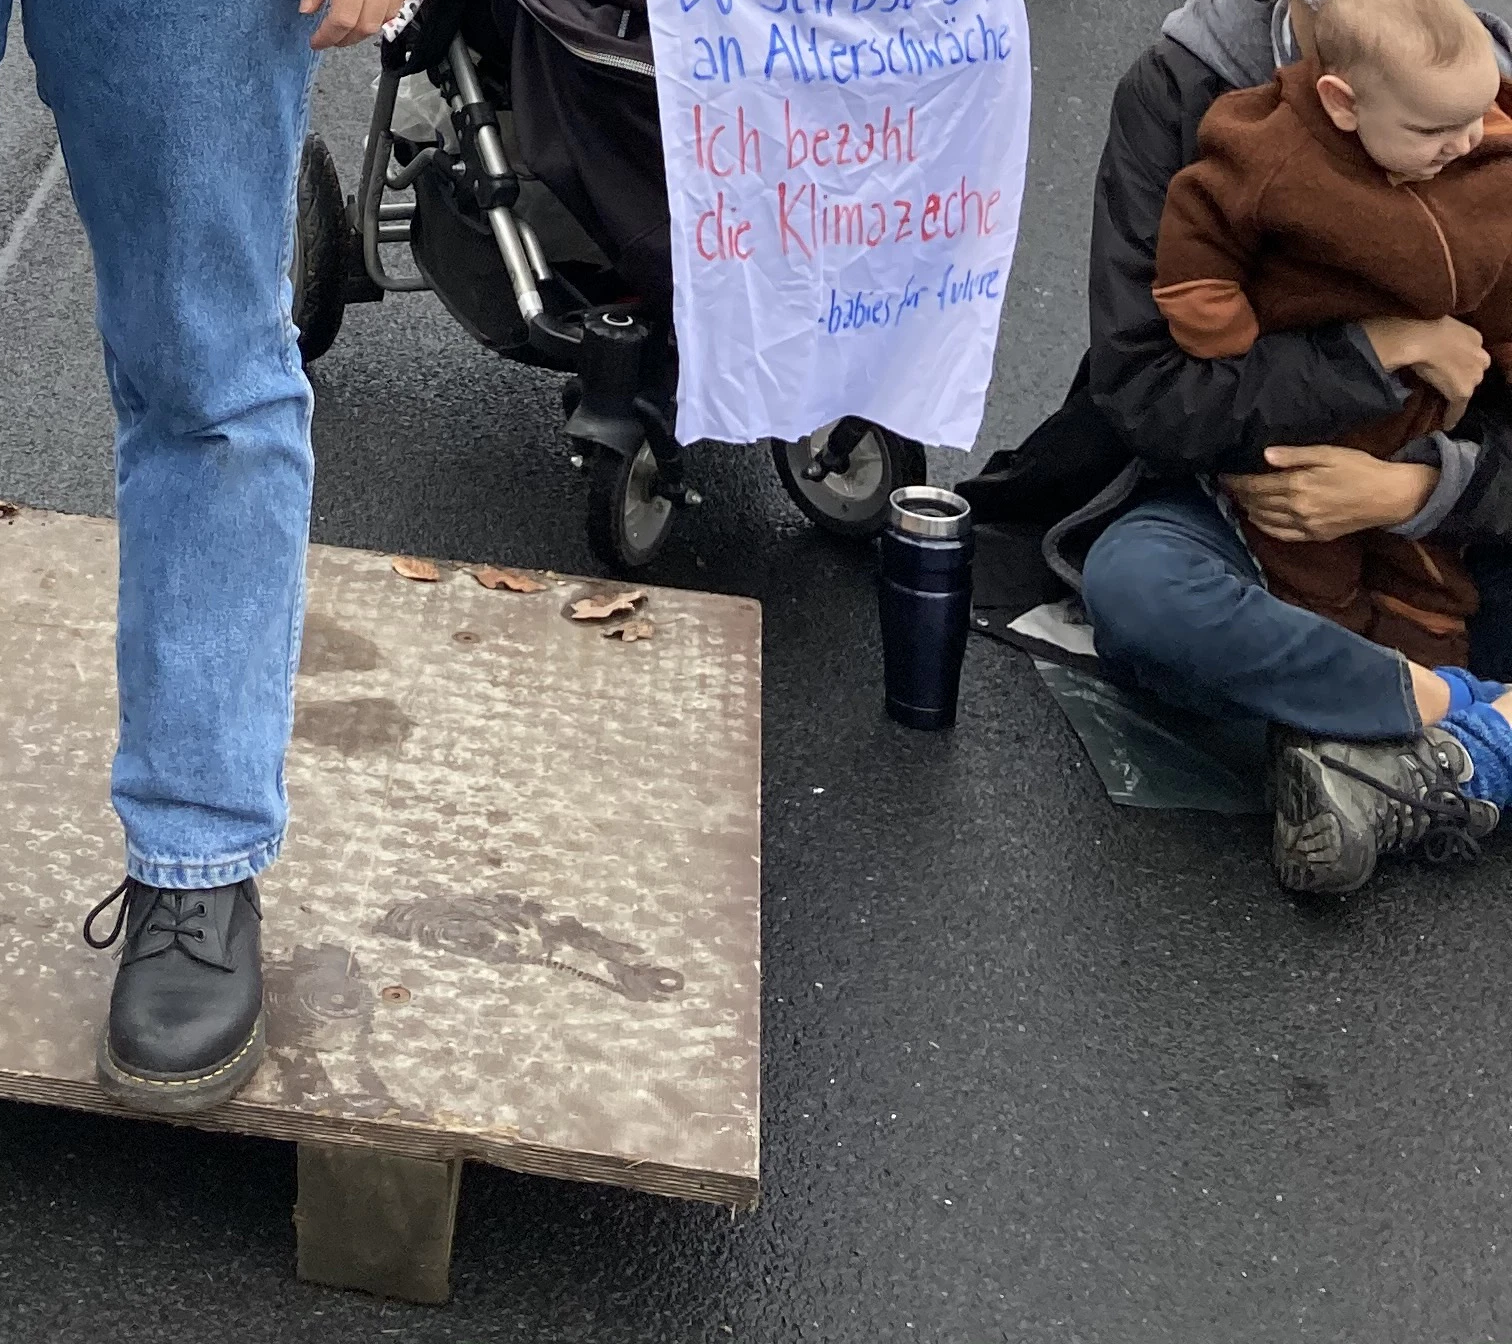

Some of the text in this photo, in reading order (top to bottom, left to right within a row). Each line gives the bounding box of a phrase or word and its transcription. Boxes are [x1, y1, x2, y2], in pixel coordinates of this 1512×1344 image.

[693, 14, 1012, 84] an Alterschwäche
[693, 98, 920, 176] Ich bezahl
[695, 175, 1002, 262] die Klimazeche
